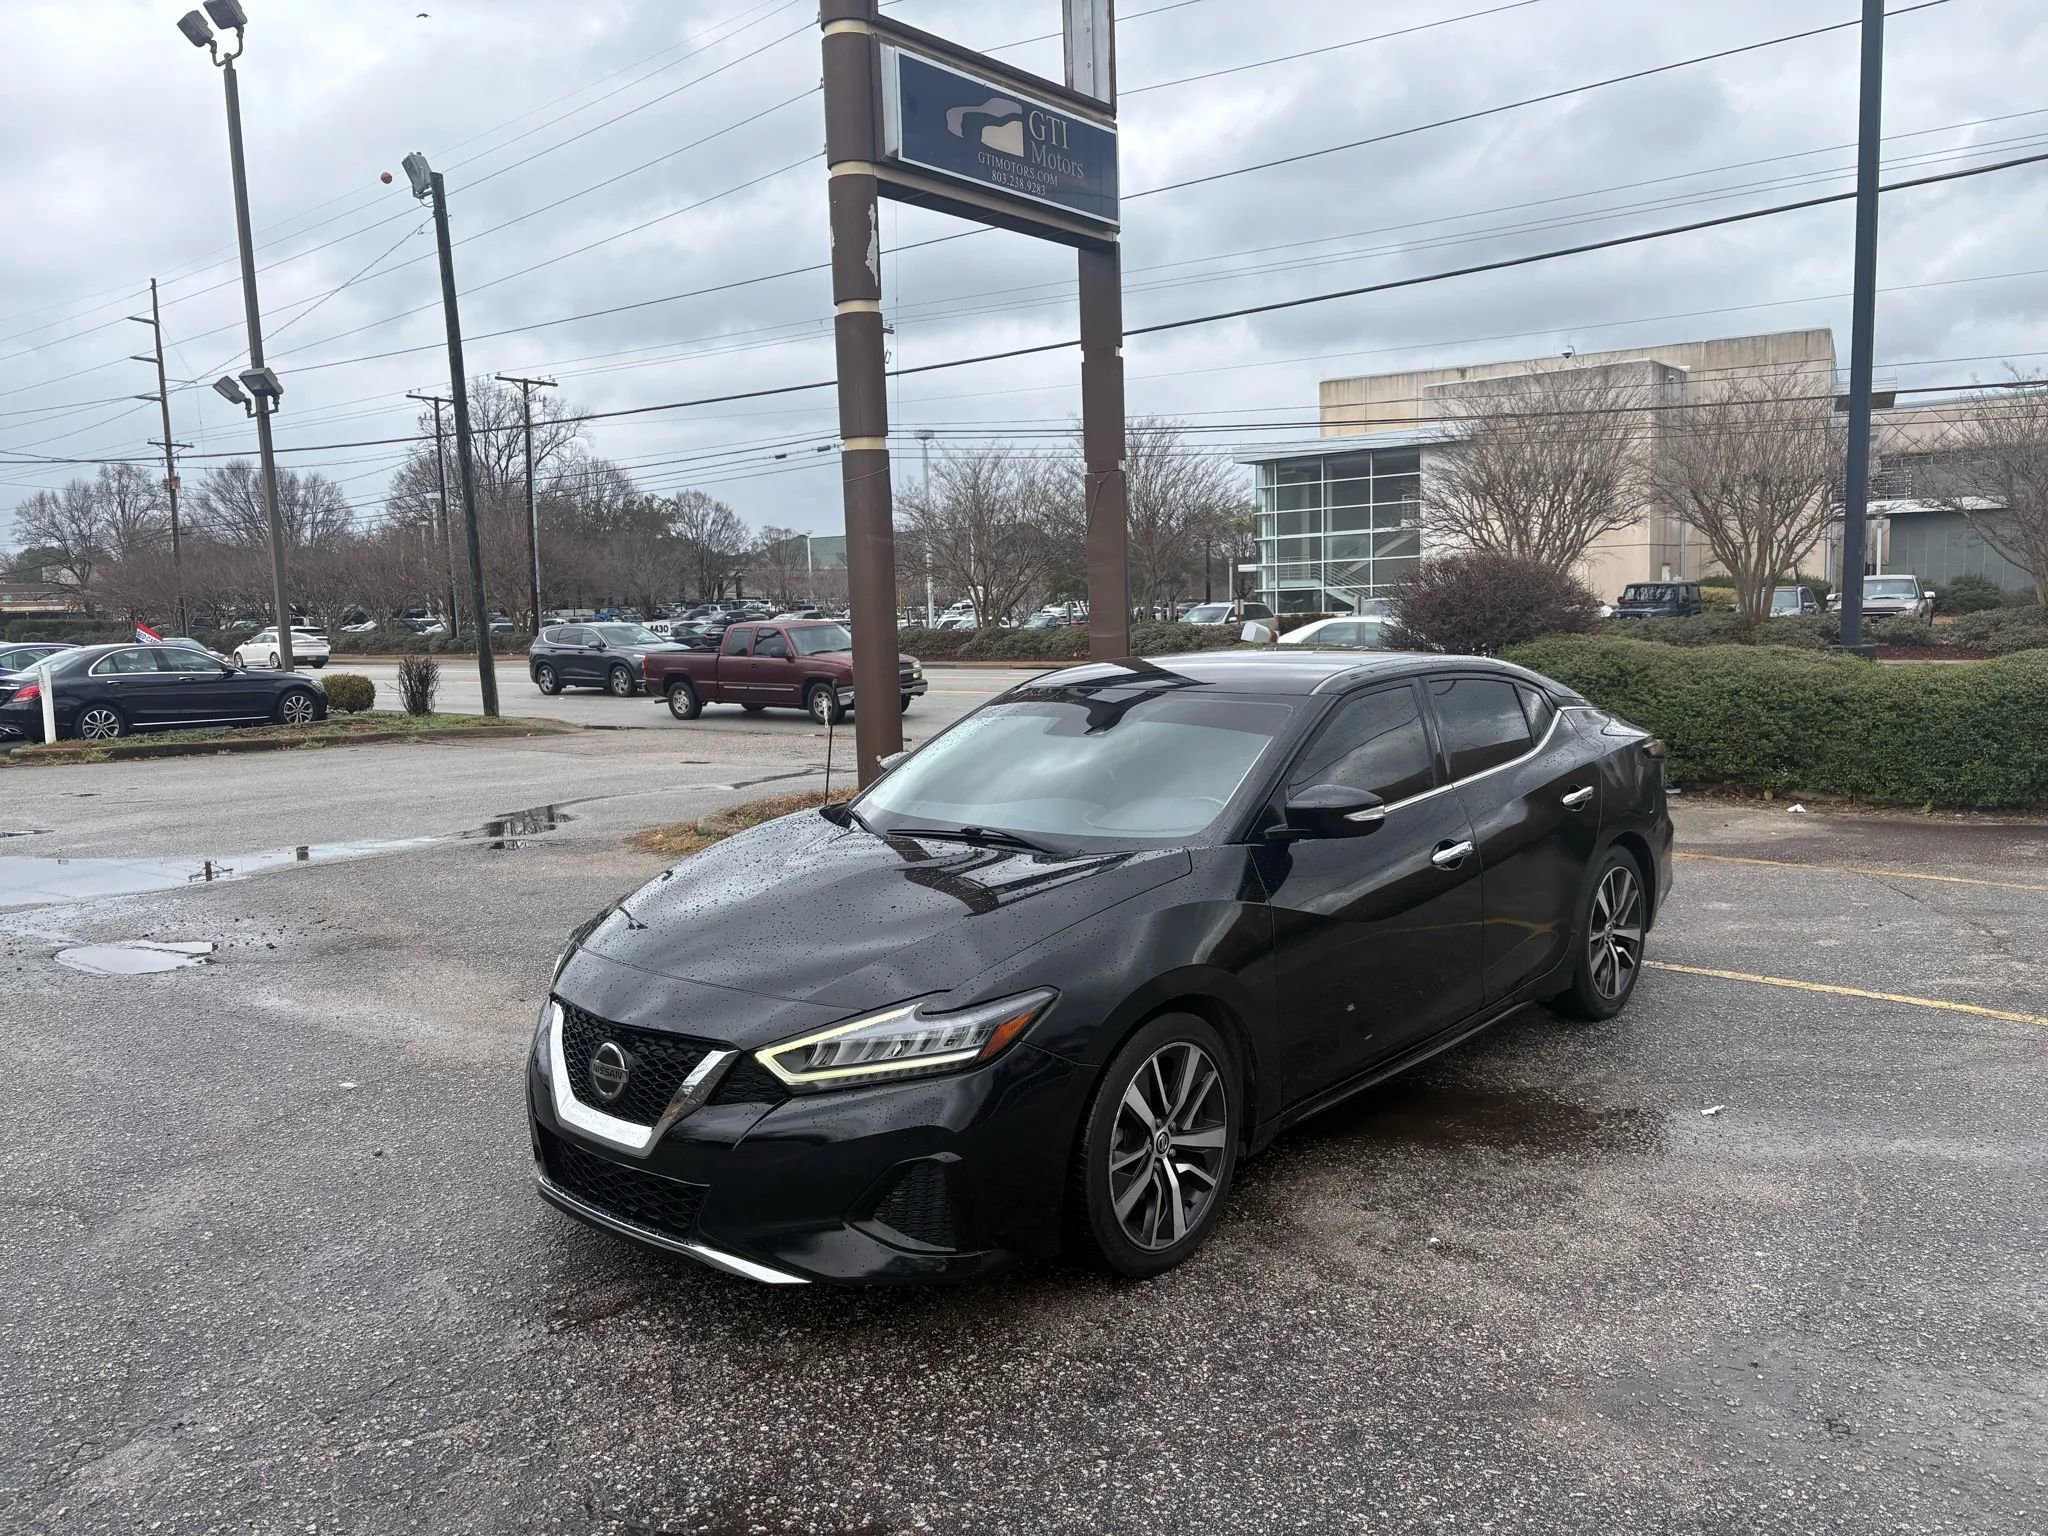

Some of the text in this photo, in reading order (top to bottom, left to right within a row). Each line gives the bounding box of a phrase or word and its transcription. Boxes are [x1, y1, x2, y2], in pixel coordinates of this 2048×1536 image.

[1029, 110, 1069, 149] GTI
[978, 151, 1058, 187] GTIMOTORS.COM
[1031, 141, 1084, 179] Motors
[991, 169, 1046, 196] 803.238.9283
[593, 1063, 622, 1080] NISSAN
